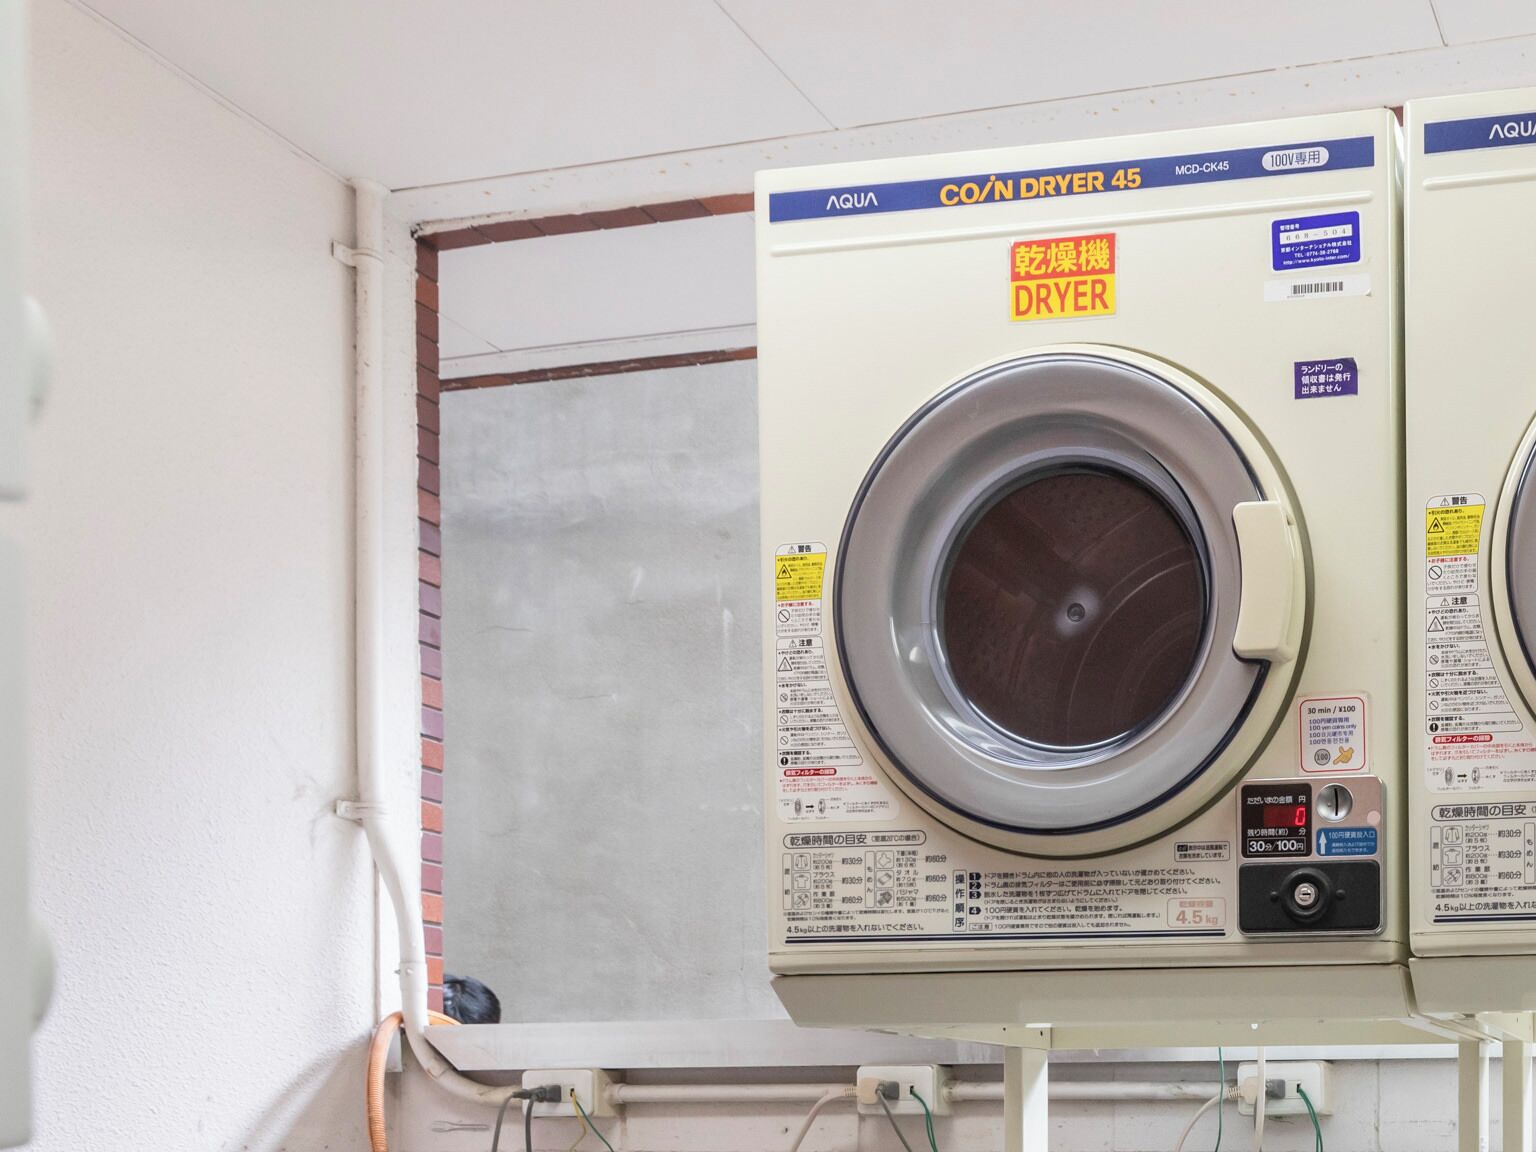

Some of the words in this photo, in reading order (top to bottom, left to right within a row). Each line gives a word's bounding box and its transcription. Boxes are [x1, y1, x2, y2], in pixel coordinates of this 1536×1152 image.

[826, 192, 878, 210] AQUA
[939, 174, 1013, 206] COIN
[1020, 171, 1105, 198] DRYER
[1112, 167, 1142, 189] 45
[1175, 160, 1230, 176] MCD-CK45
[1270, 150, 1321, 168] 100V専用
[1014, 238, 1110, 277] 乾燥機
[1014, 278, 1110, 317] DRYER
[1301, 363, 1343, 375] ランドリーの
[1301, 372, 1351, 385] 領収書は発行
[1301, 383, 1342, 395] 出来ません
[1452, 496, 1467, 505] 警告
[798, 545, 811, 553] 警告
[1451, 596, 1467, 605] 注意
[799, 639, 812, 647] 注意
[1332, 705, 1336, 714] /
[1317, 753, 1328, 761] 100
[1247, 795, 1293, 805] ただいまの金額
[1298, 795, 1306, 803] 円
[1294, 807, 1306, 826] 0
[1439, 805, 1526, 818] 乾燥時間の目安
[1298, 827, 1306, 836] 分
[1328, 830, 1376, 839] 100円硬貨投入口
[1497, 829, 1522, 838] 約30分
[790, 834, 867, 846] 乾燥時間の目安
[1249, 839, 1304, 852] 30分/100円
[1497, 850, 1522, 859] 約30分
[842, 857, 863, 866] 約30分
[1497, 871, 1522, 880] 約60分
[1176, 910, 1203, 924] 4.5
[1206, 915, 1218, 926] kg
[786, 923, 925, 934] 4.5kg以上の洗濯物を入れないでください。
